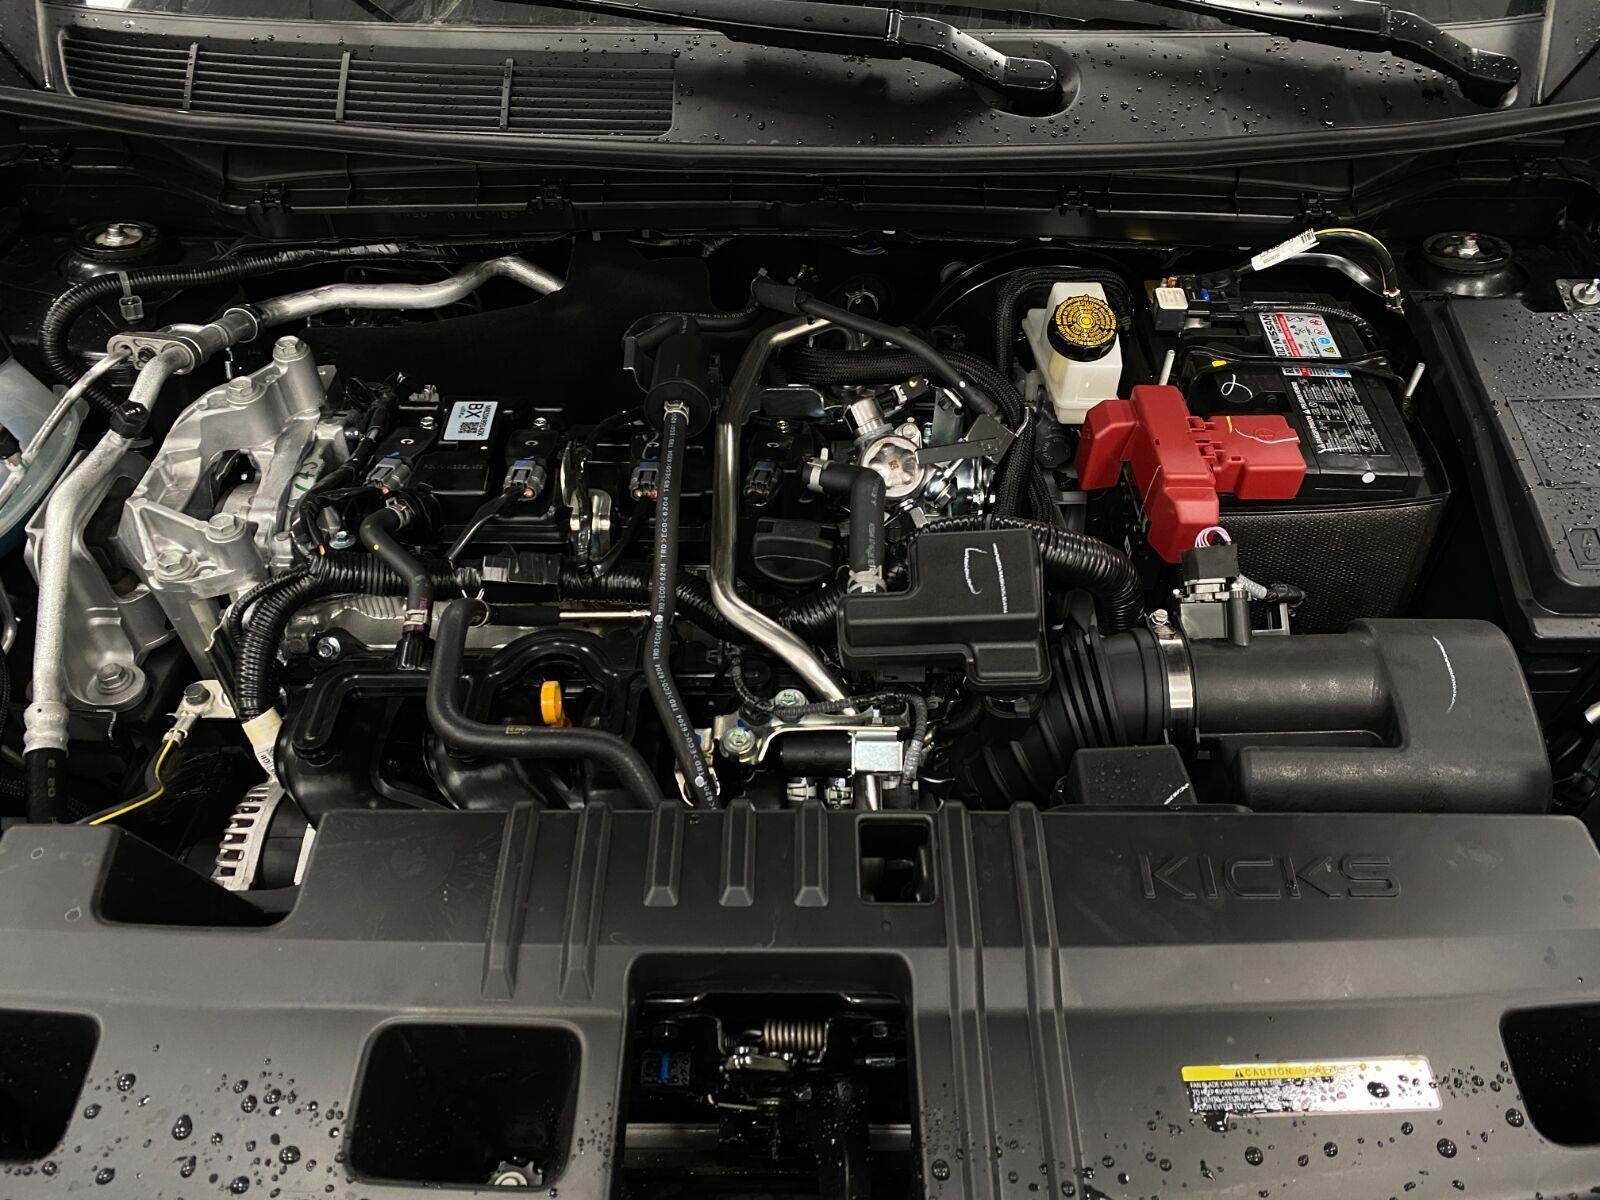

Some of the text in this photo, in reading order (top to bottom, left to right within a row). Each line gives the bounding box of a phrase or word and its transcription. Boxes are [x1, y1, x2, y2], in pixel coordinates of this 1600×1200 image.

[1261, 314, 1282, 345] NISSAN
[464, 403, 484, 418] BX
[1138, 854, 1402, 900] KICKS
[1245, 1067, 1292, 1077] CAUTION
